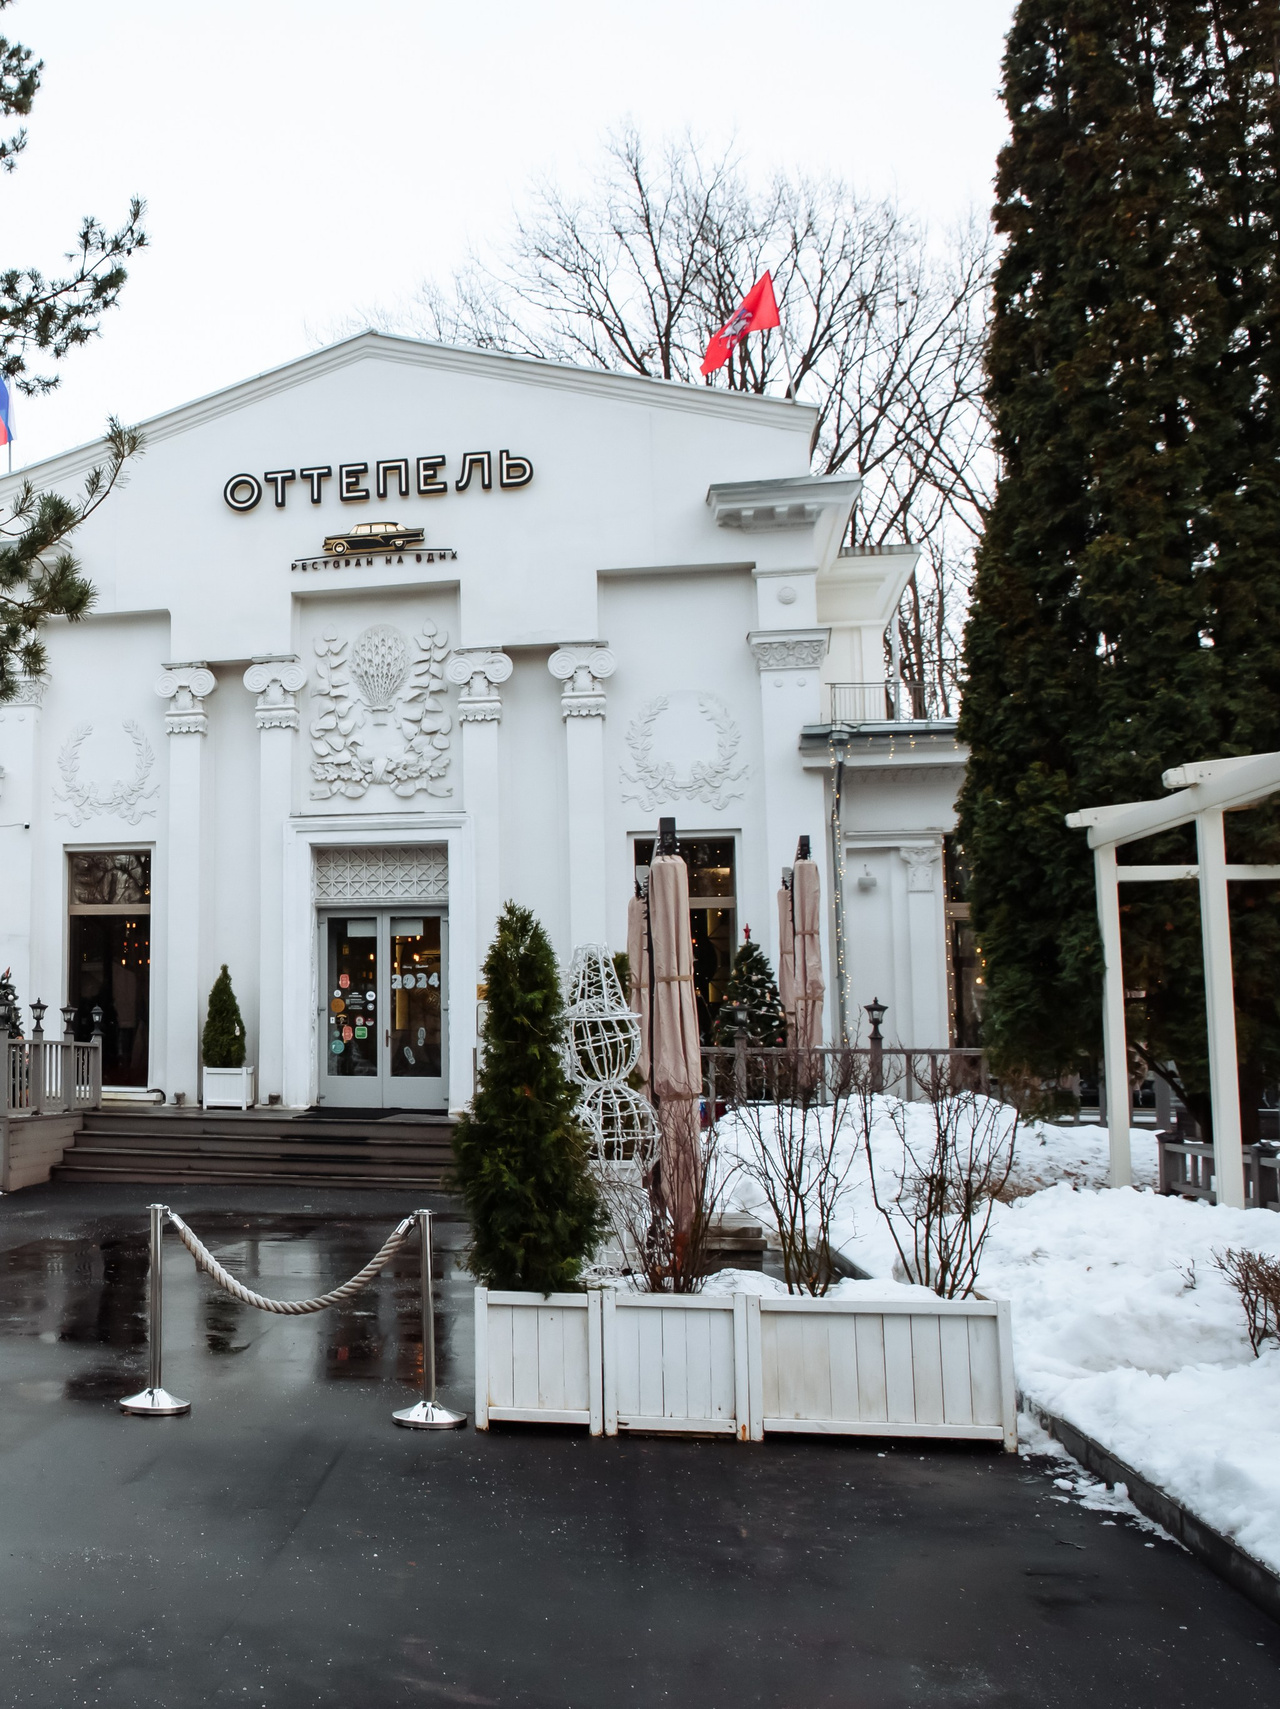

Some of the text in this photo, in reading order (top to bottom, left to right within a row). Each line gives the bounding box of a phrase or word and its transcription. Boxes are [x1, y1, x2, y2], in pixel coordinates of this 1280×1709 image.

[223, 449, 534, 512] ОТТЕПЕЛЬ
[291, 551, 458, 572] РЕСТОРАН НА ВДНХ
[391, 972, 440, 989] 2024
